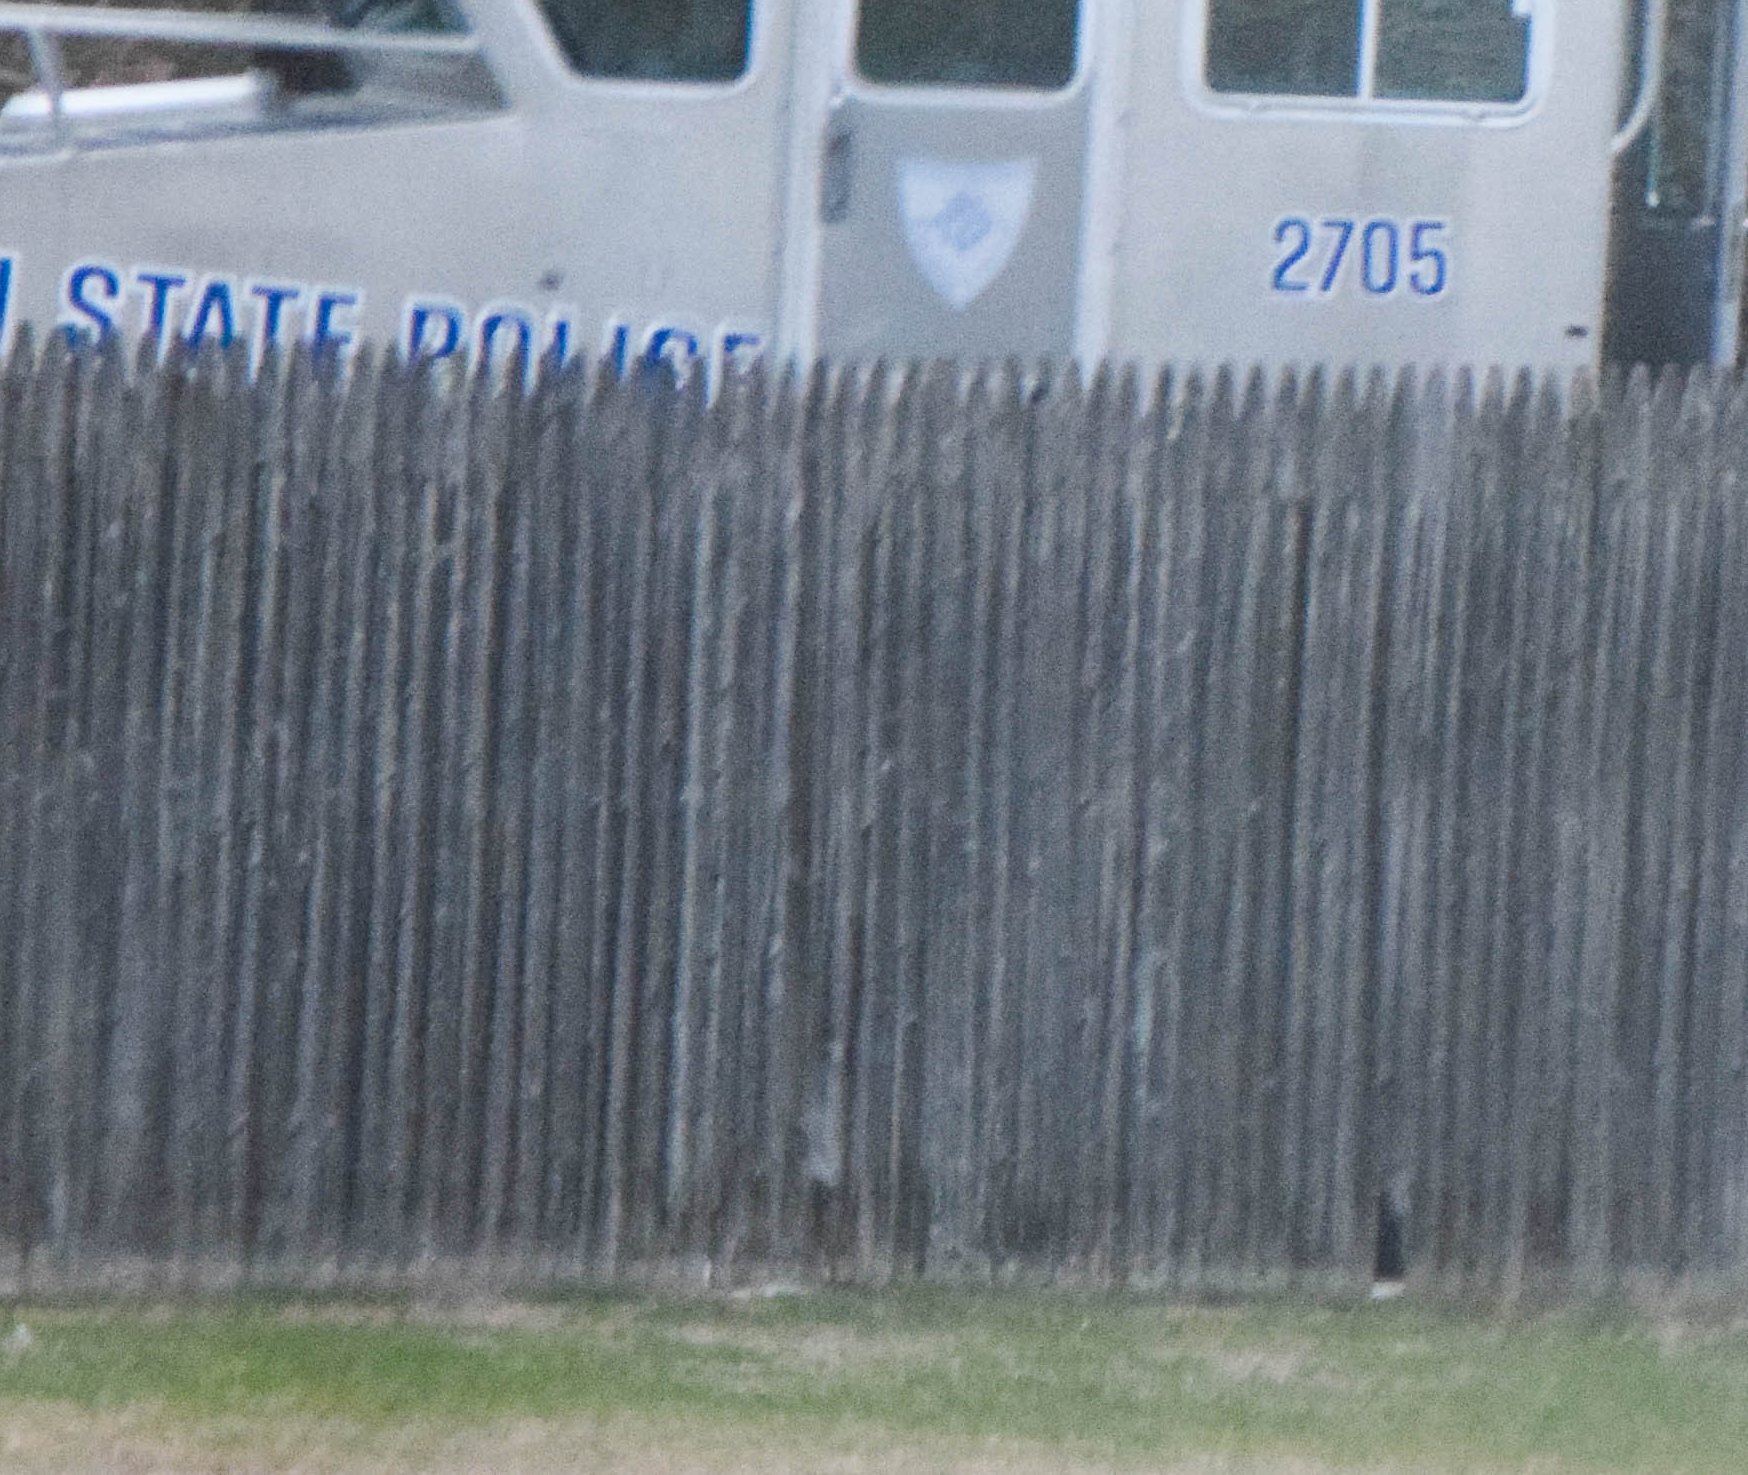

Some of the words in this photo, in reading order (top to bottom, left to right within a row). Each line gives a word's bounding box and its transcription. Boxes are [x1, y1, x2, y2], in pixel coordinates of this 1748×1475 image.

[1271, 217, 1448, 294] 2705
[60, 261, 360, 365] STATE
[407, 305, 764, 395] POI
